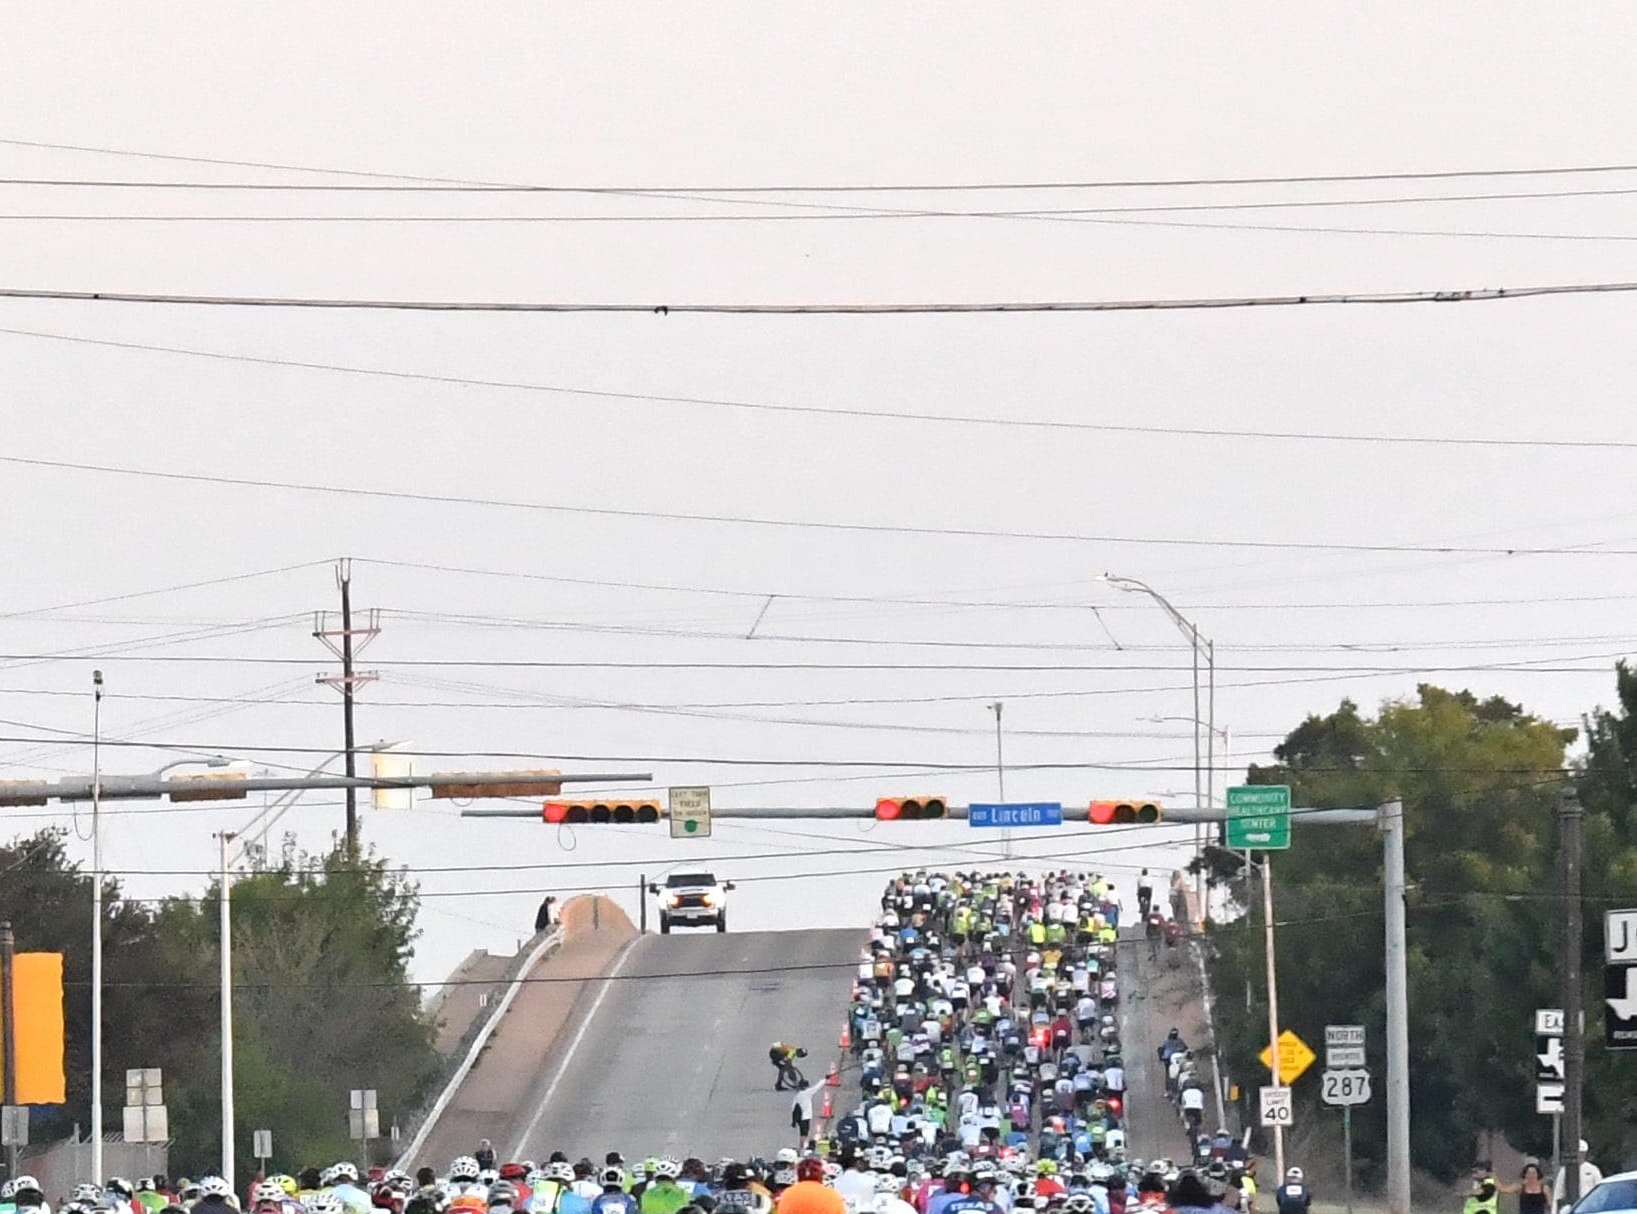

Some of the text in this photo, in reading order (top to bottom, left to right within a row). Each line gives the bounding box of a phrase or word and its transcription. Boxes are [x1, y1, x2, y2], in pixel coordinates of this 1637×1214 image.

[991, 807, 1041, 823] Lincoln
[1327, 1030, 1362, 1040] NORTH
[1327, 1076, 1366, 1098] 287
[1265, 1107, 1289, 1120] 40
[951, 1201, 994, 1211] TEXAS
